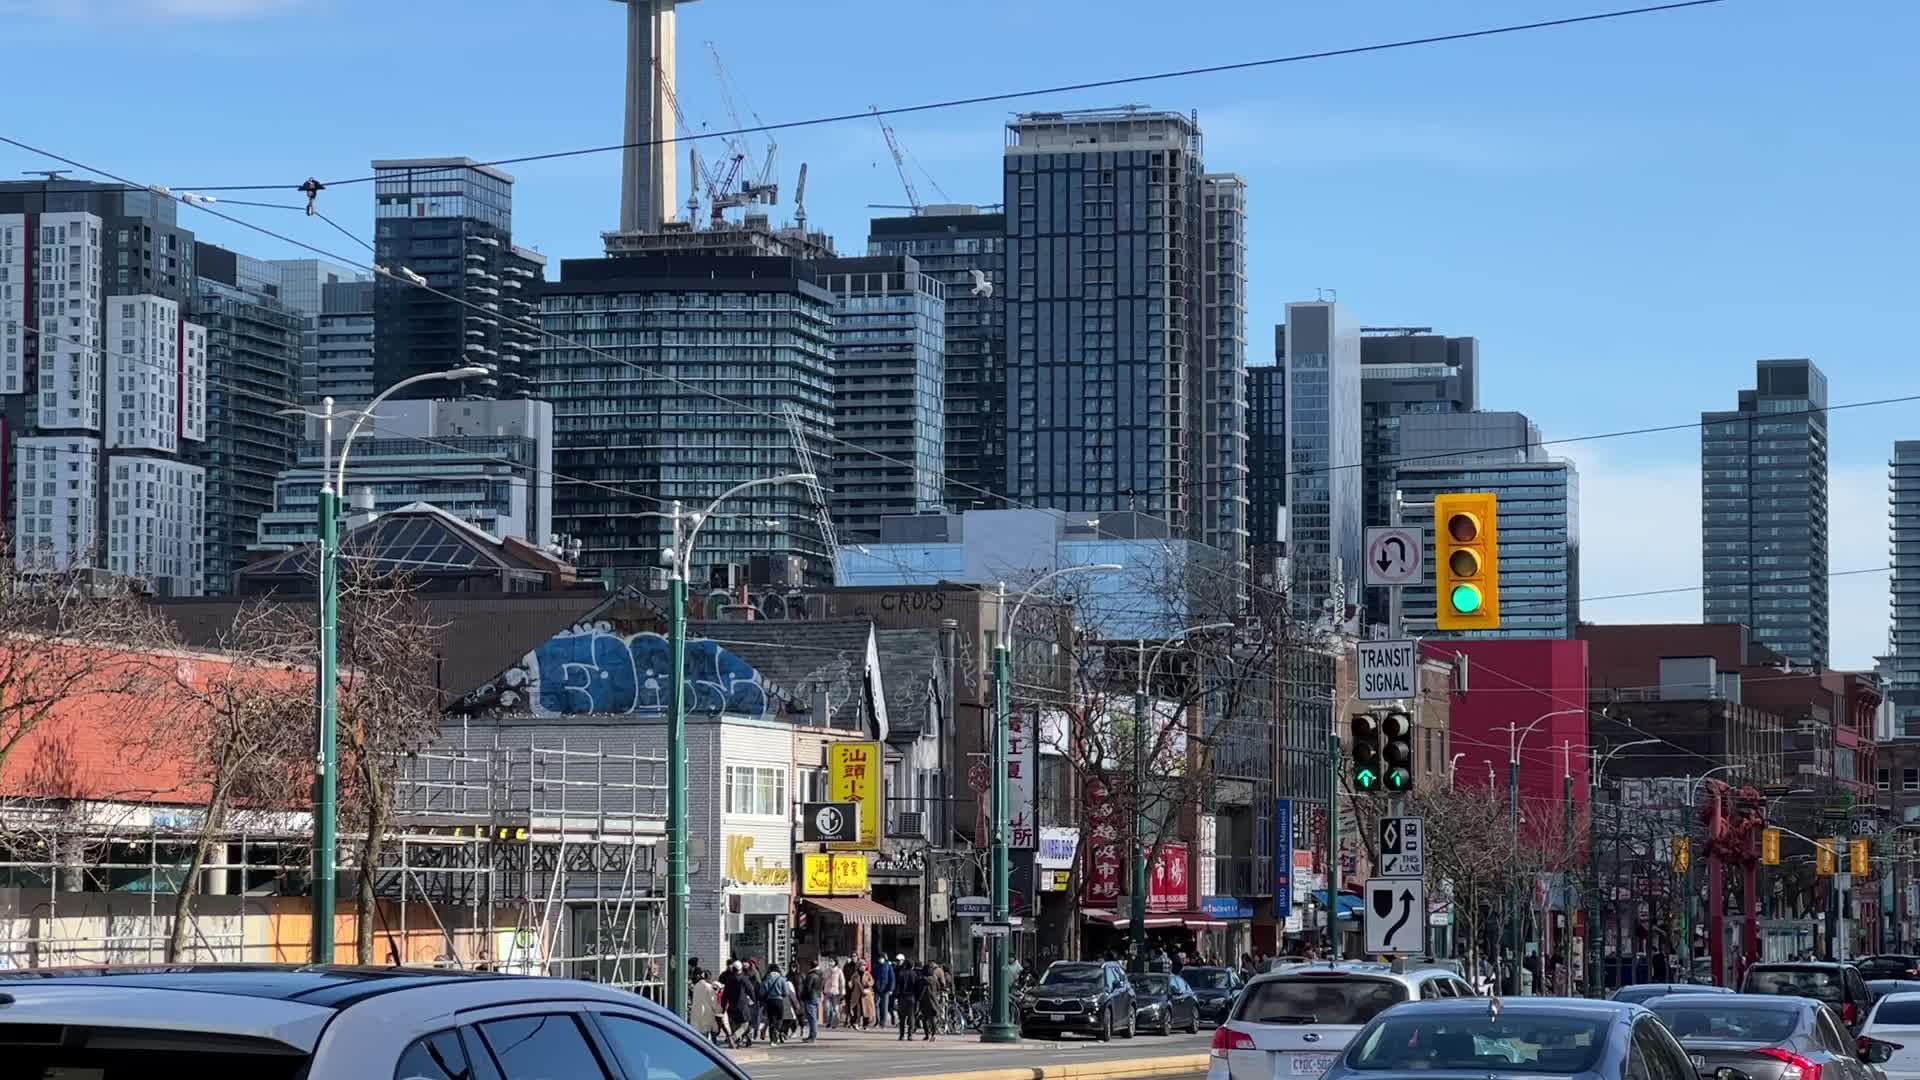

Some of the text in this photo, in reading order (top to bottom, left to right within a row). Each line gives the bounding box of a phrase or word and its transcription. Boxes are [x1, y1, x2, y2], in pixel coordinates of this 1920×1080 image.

[1361, 648, 1411, 668] TRANSIT
[1365, 672, 1409, 692] SIGNAL
[1279, 808, 1287, 842] Montreal
[1400, 864, 1420, 872] LANE
[1402, 855, 1419, 863] THIS
